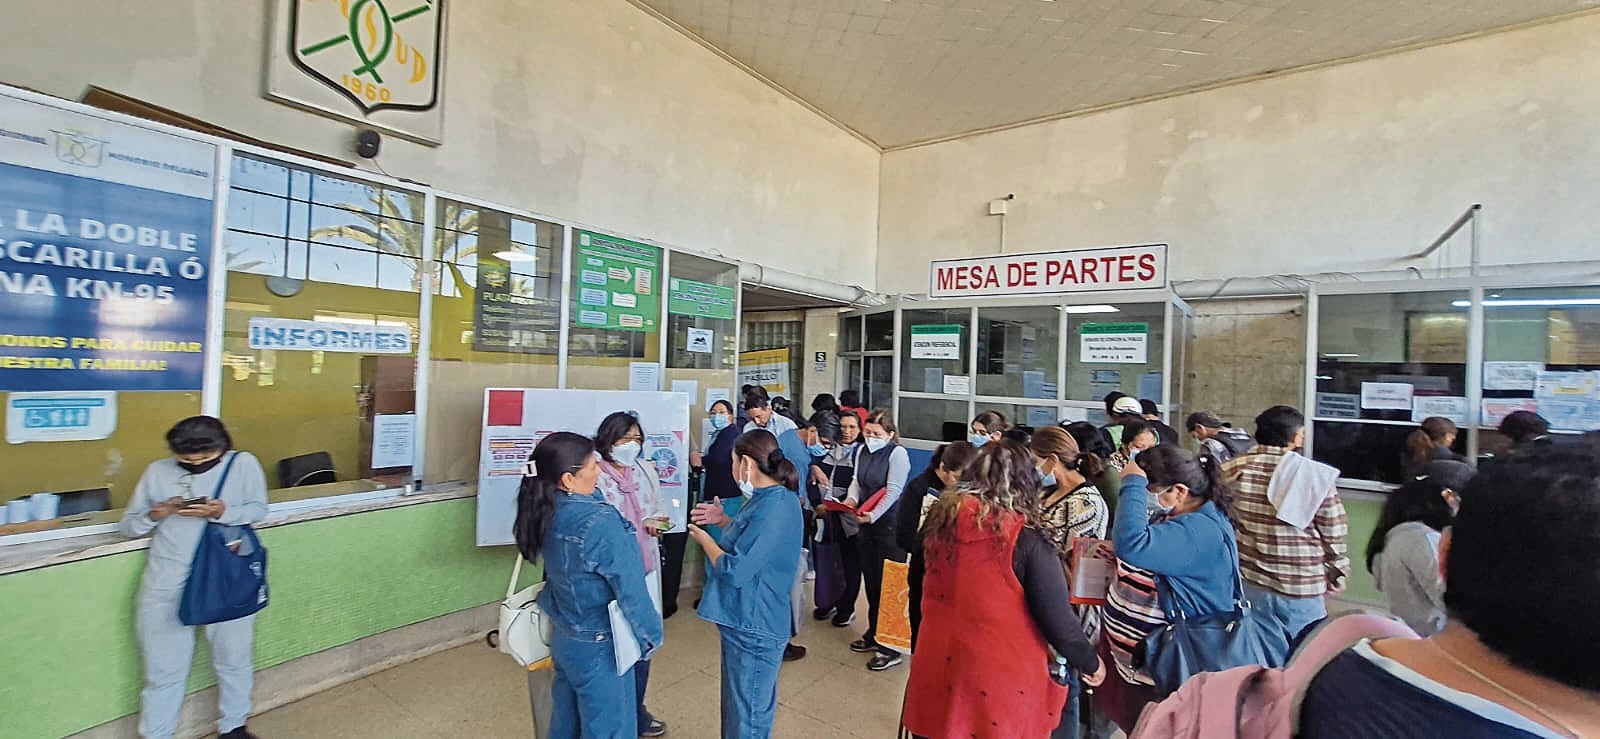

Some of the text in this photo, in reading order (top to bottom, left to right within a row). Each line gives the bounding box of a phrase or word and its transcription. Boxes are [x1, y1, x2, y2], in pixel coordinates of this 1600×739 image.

[341, 73, 391, 102] 1960
[16, 209, 200, 252] LA DOBLE
[178, 256, 205, 280] Ó
[937, 253, 1157, 290] MESA DE PARTES
[66, 277, 176, 305] KN-95
[71, 337, 128, 350] PARA
[132, 341, 203, 353] CUIDAR
[251, 326, 409, 349] INFORMES
[817, 352, 825, 361] S
